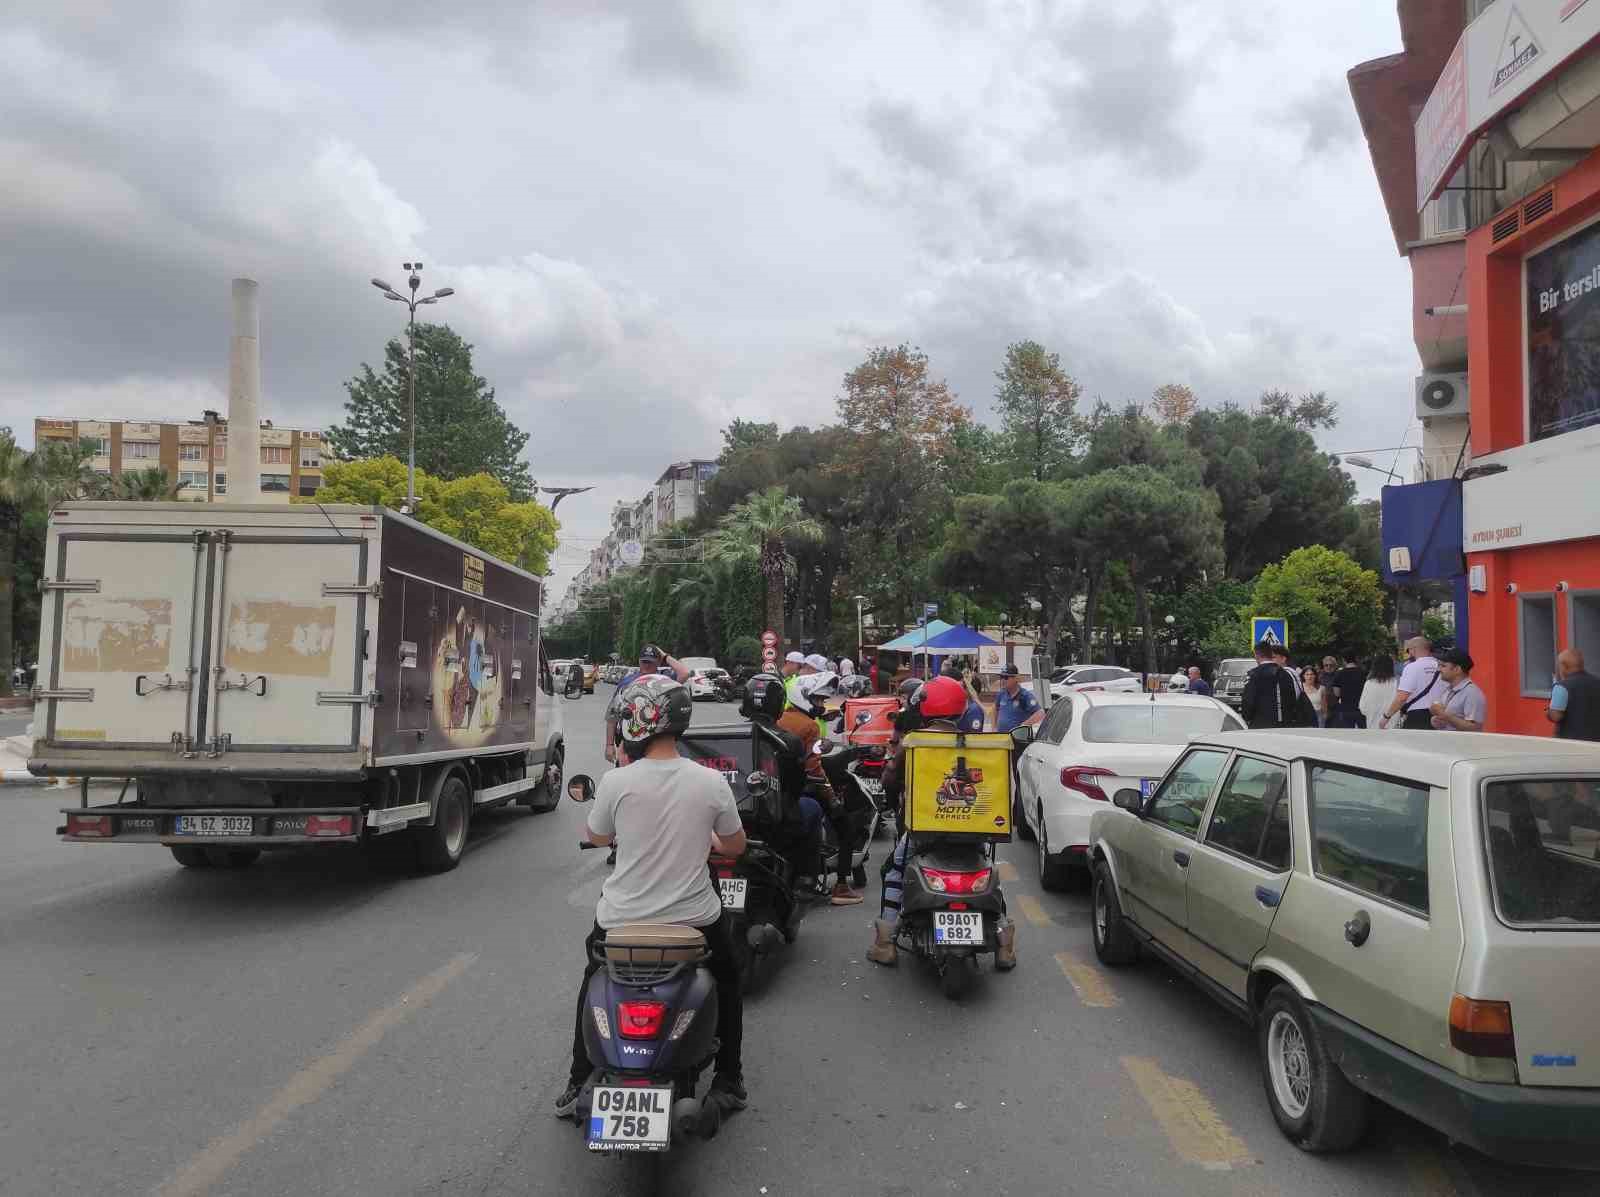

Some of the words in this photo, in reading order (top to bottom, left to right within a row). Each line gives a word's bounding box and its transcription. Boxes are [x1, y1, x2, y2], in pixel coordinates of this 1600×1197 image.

[1540, 288, 1559, 313] Bir
[936, 806, 972, 814] MOTO
[934, 813, 971, 821] EXPRESS
[182, 817, 196, 830] 34
[222, 817, 250, 830] 3032
[721, 881, 744, 892] AHG
[721, 894, 735, 906] 23
[947, 927, 972, 939] 682
[598, 1090, 665, 1113] 09ANL
[610, 1115, 650, 1137] 758
[614, 1143, 640, 1151] MOTOR
